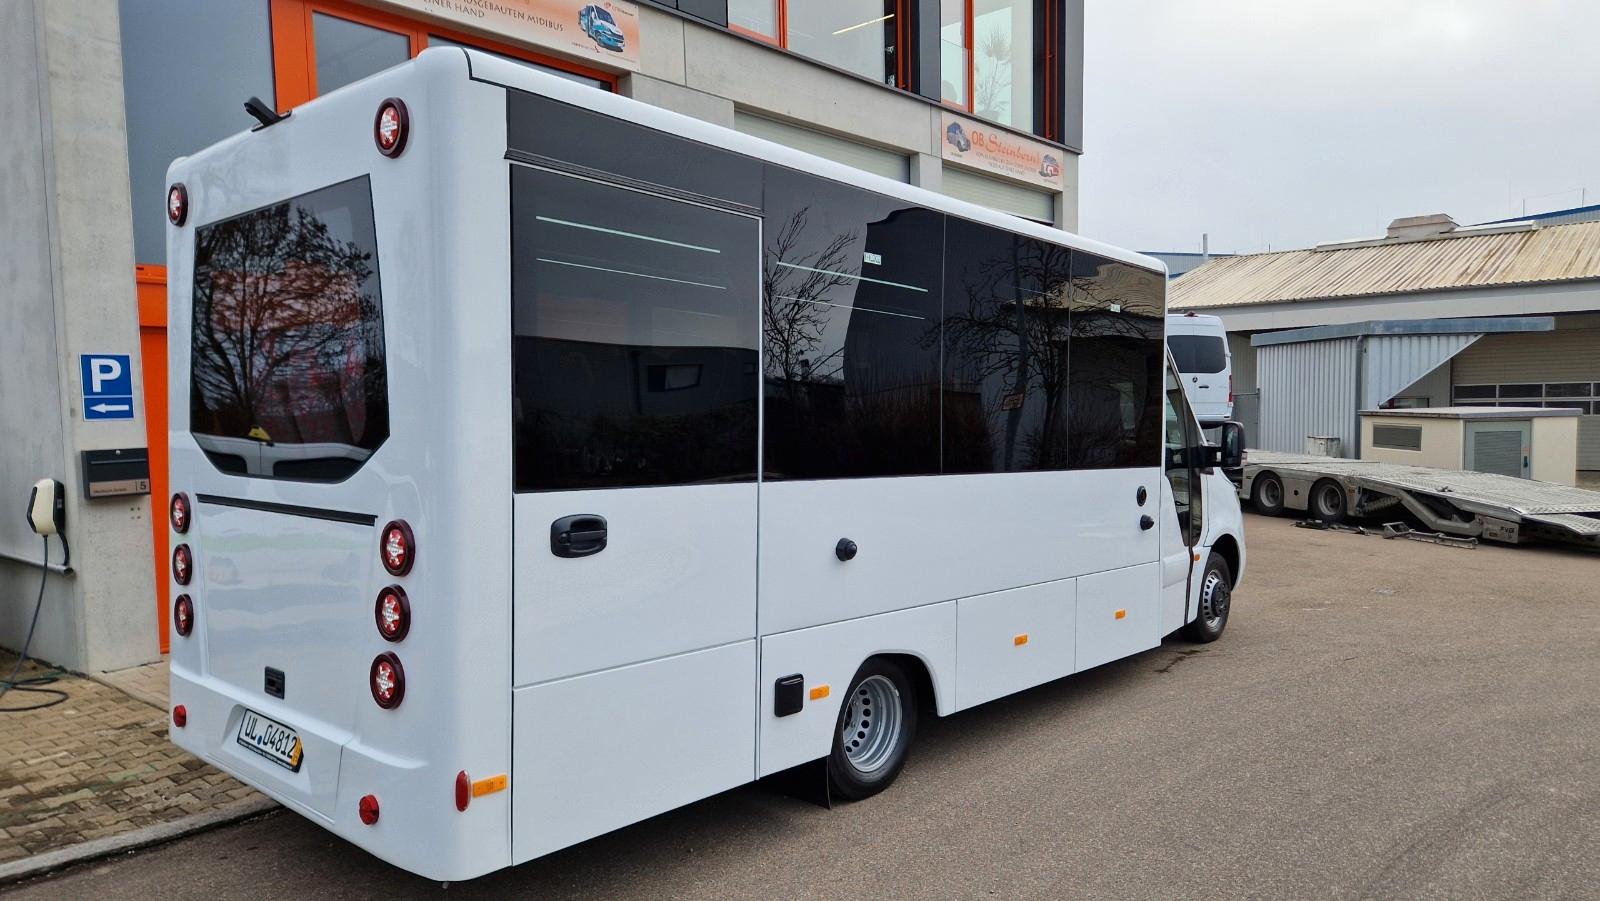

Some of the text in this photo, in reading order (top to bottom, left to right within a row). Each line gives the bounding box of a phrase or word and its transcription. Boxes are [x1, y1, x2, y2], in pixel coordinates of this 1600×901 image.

[454, 3, 485, 18] HAND
[463, 0, 564, 32] USGEBAUTEN MIDIBUS
[971, 130, 985, 147] OB
[90, 358, 122, 393] P
[140, 481, 147, 490] 5
[244, 715, 258, 741] UL
[262, 724, 298, 759] 04812
